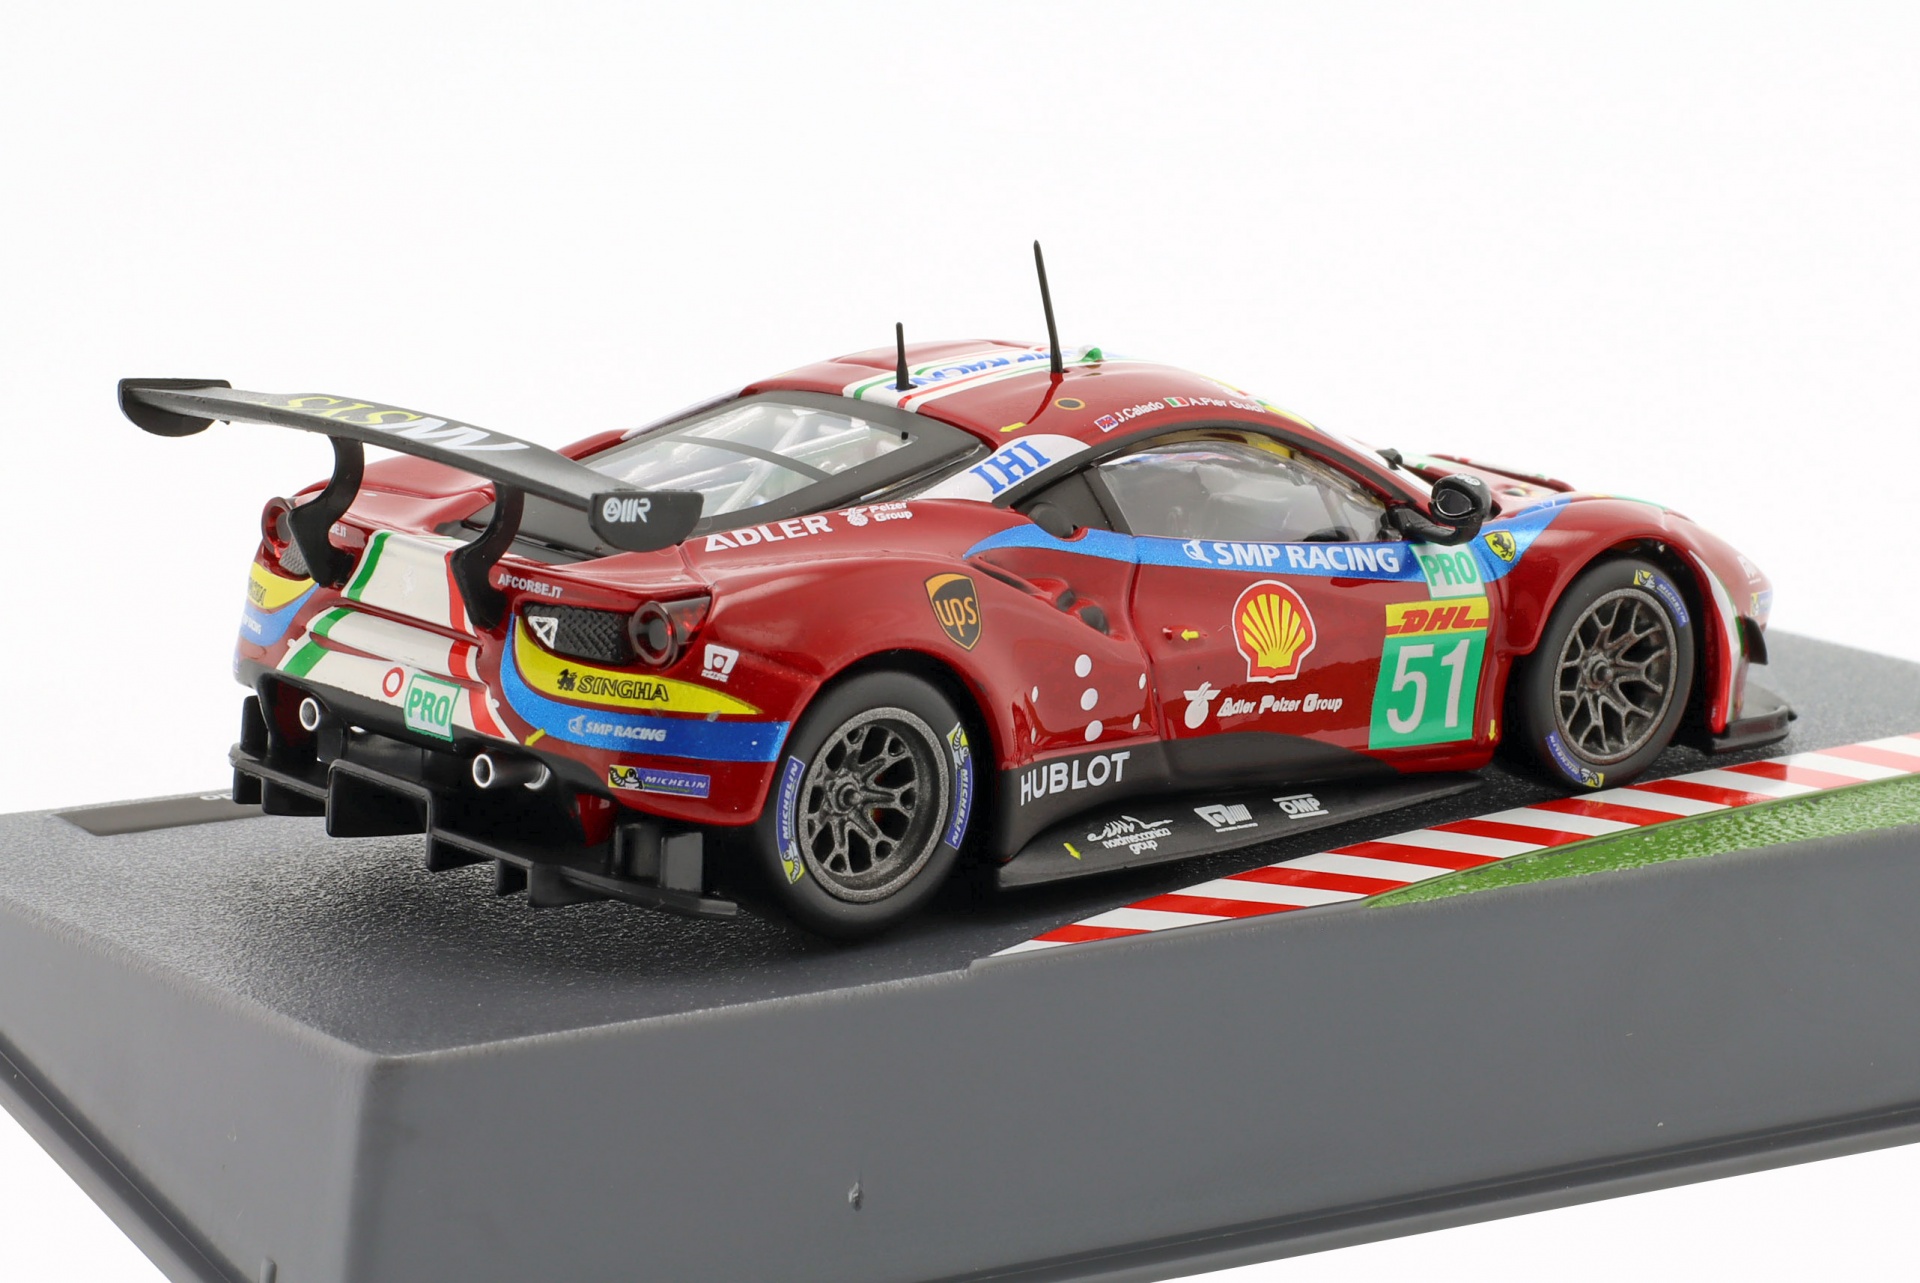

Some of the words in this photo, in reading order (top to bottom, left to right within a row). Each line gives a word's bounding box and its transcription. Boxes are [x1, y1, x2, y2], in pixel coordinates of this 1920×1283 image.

[1115, 401, 1165, 424] J.Calado
[969, 440, 1051, 495] IHI
[869, 501, 908, 514] Pelzer
[873, 507, 913, 523] Group
[704, 515, 833, 552] ADLER
[1216, 543, 1281, 567] SMP
[1287, 545, 1401, 573] RACING
[1420, 552, 1477, 587] PRO
[498, 573, 563, 599] AFCORSE.IT
[935, 596, 977, 637] ups
[1398, 606, 1475, 634] DHL
[578, 675, 670, 701] SINGHA
[1386, 638, 1471, 734] 51
[408, 687, 450, 727] PRO
[1216, 697, 1256, 718] Adler
[1258, 695, 1301, 714] Pelzer
[1302, 693, 1343, 713] Group
[586, 721, 613, 735] SMP
[613, 725, 667, 742] RACING
[644, 775, 707, 789] MICHELIN
[1020, 751, 1131, 806] HUBLOT
[782, 763, 799, 841] MICHELIN
[952, 768, 969, 845] MICHELIN
[1278, 797, 1321, 815] OMP
[1129, 840, 1158, 855] group
